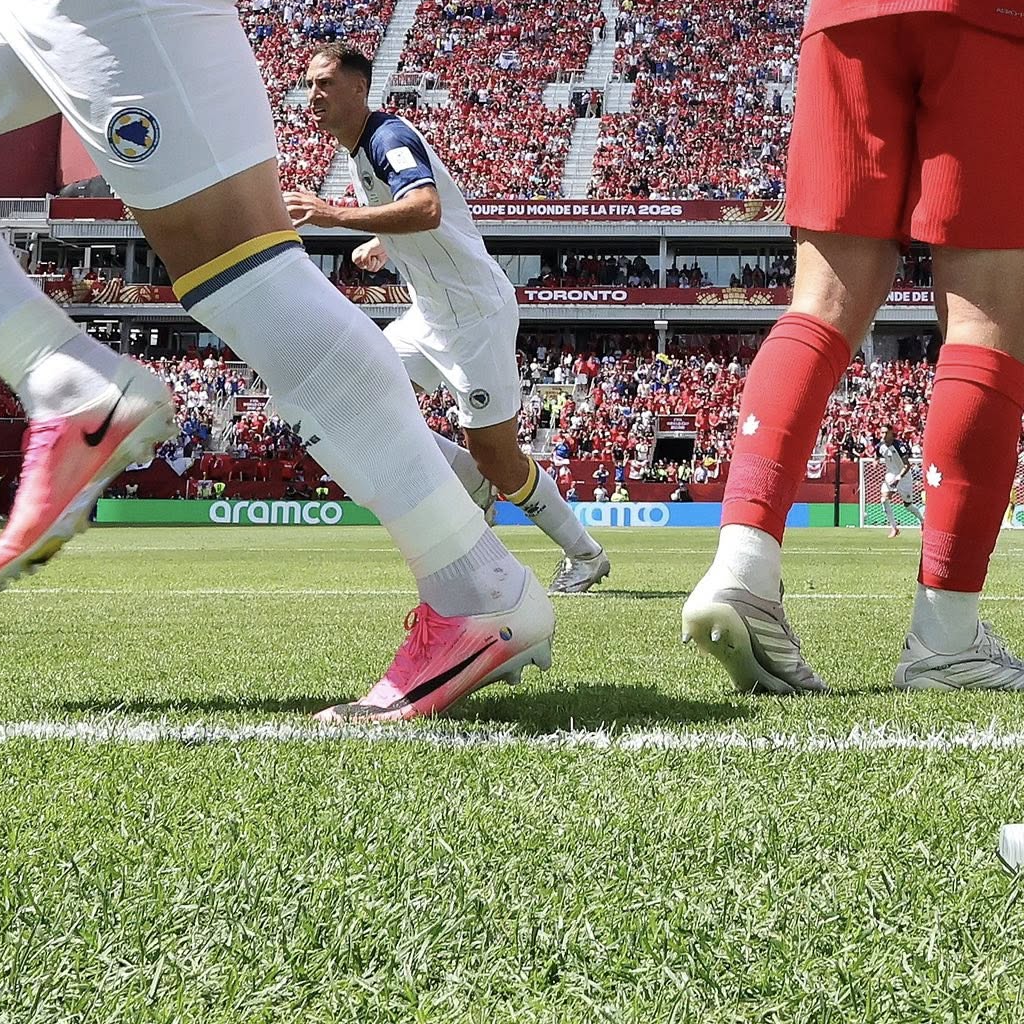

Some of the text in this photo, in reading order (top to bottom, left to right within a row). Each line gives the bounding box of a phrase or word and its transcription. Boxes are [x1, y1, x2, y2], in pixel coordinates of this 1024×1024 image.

[507, 204, 525, 215] DU
[527, 204, 571, 215] MONDE
[572, 204, 589, 215] DE
[590, 204, 608, 215] LA
[609, 204, 637, 215] FIFA
[638, 204, 683, 215] 2026
[524, 290, 628, 301] TORONTO
[912, 291, 929, 302] DE
[209, 500, 343, 524] aramco
